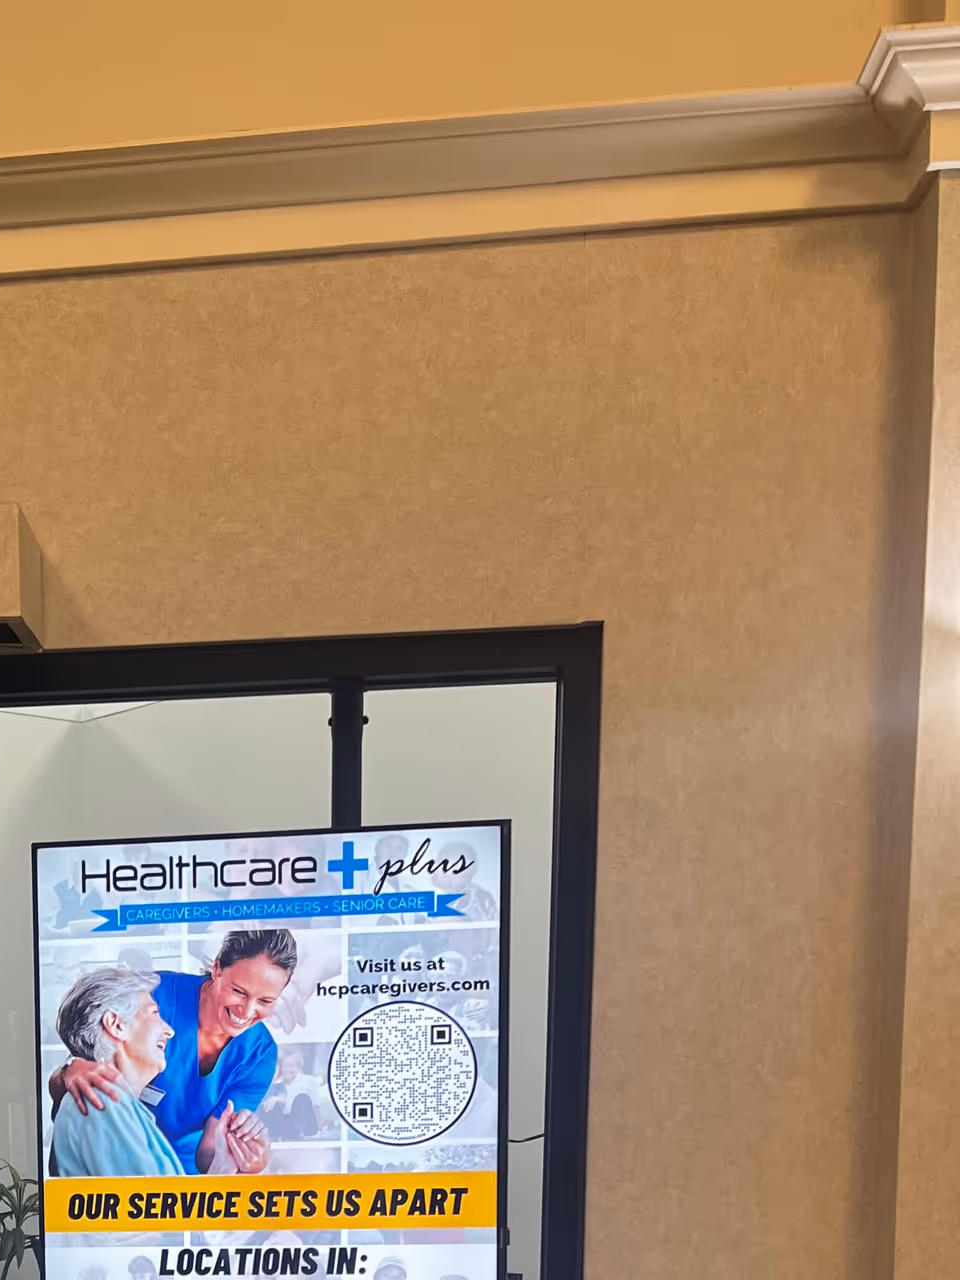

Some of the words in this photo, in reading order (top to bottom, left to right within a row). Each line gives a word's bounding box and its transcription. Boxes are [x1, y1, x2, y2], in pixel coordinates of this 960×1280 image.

[82, 854, 318, 893] Healthcare
[374, 838, 475, 895] plus
[126, 905, 210, 921] CAREGIVERS
[222, 901, 321, 917] HOMEMAKERS
[331, 897, 383, 913] SENIOR
[387, 896, 426, 910] CARE
[356, 959, 396, 974] Visit
[401, 961, 421, 972] us
[427, 957, 445, 971] at
[316, 977, 490, 998] hcpcaregivers.com
[67, 1192, 120, 1220] OUR
[127, 1190, 239, 1219] SERVICE
[247, 1189, 318, 1218] SETS
[325, 1188, 362, 1217] US
[369, 1187, 468, 1216] APART
[159, 1248, 318, 1276] LOCATIONS
[326, 1247, 368, 1275] IN:
